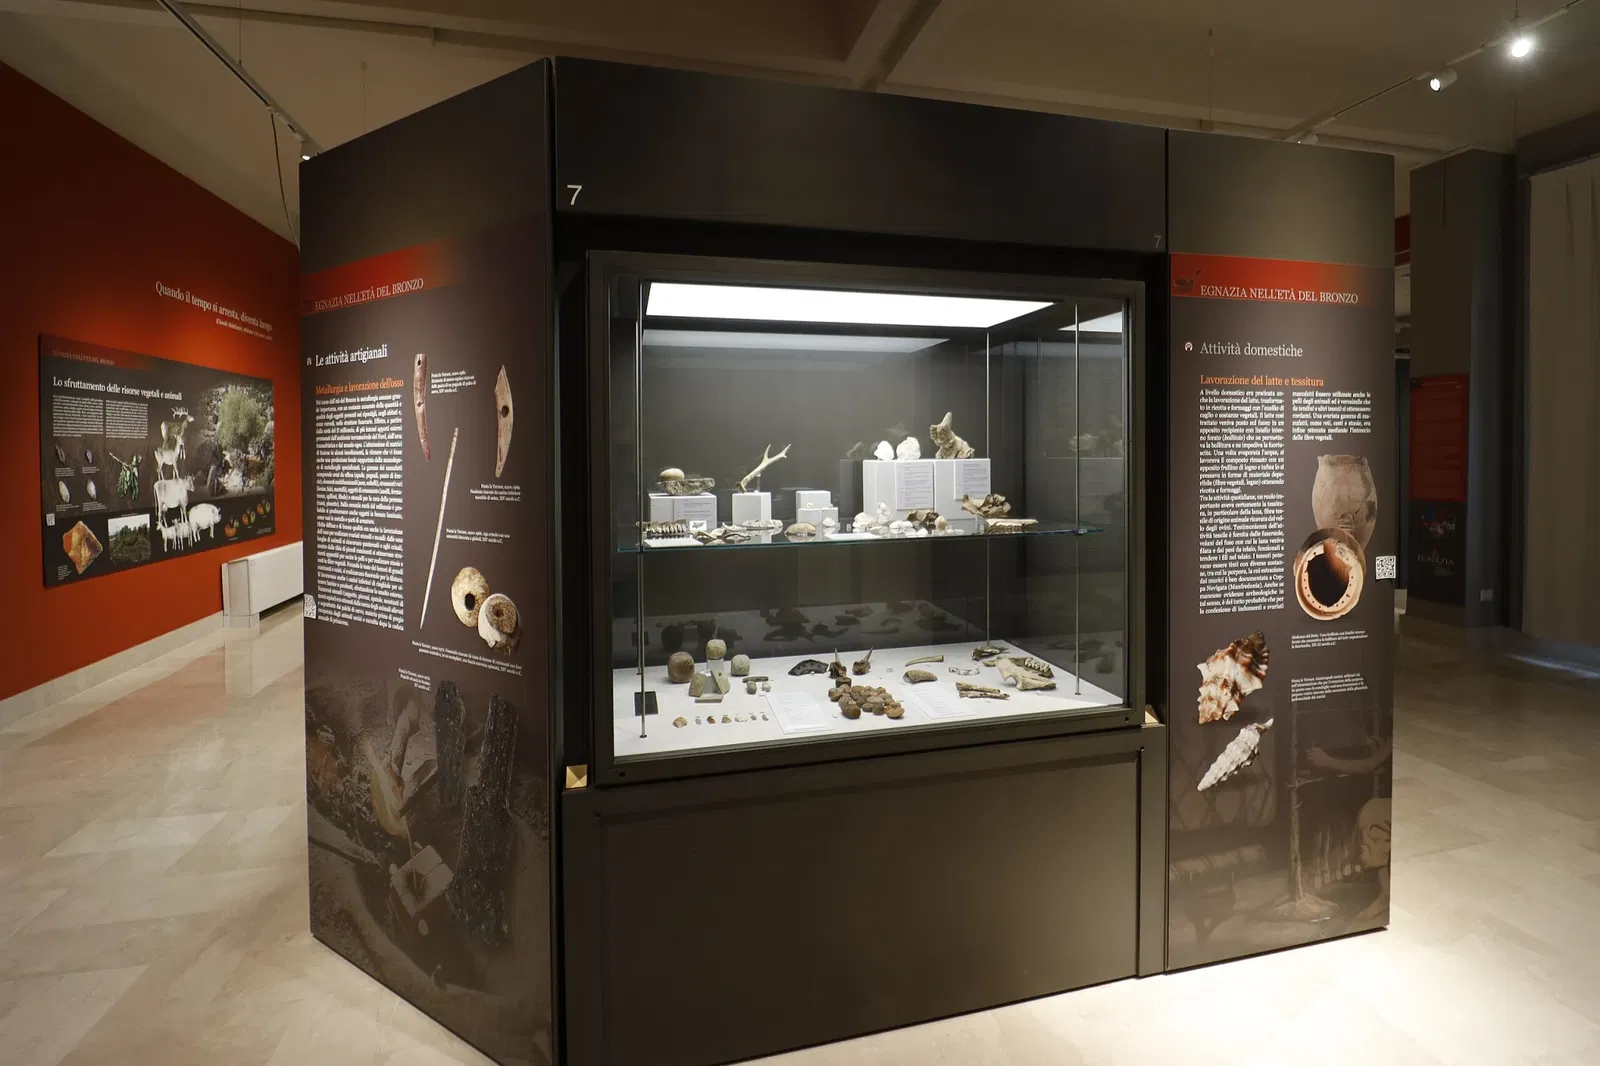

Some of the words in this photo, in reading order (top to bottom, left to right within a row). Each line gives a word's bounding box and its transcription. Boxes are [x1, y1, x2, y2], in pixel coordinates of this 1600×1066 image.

[566, 184, 582, 205] 7
[1153, 234, 1162, 248] 7
[314, 296, 343, 311] EGNAZIA
[376, 285, 390, 298] DEL
[392, 278, 424, 294] BRONZO
[1200, 285, 1246, 298] EGNAZIA
[1298, 290, 1317, 302] DEL
[1320, 292, 1358, 304] BRONZO
[156, 281, 184, 301] Quando
[185, 291, 190, 303] il
[192, 295, 211, 311] tempo
[212, 302, 218, 313] si
[219, 306, 240, 321] arresta,
[240, 312, 259, 327] diventa
[259, 318, 272, 332] luogo
[1200, 342, 1241, 355] Attività
[1244, 342, 1303, 357] domestiche
[315, 355, 324, 366] Le
[325, 350, 349, 365] attività
[350, 344, 388, 364] artigianali
[1200, 375, 1249, 385] Lavorazione
[1251, 375, 1263, 385] del
[1265, 375, 1282, 386] latte
[1291, 376, 1324, 386] tessitura
[53, 376, 63, 387] Lo
[64, 378, 106, 392] sfruttamento
[106, 383, 120, 394] delle
[122, 385, 140, 396] risorse
[141, 389, 159, 399] vegetali
[164, 392, 182, 401] animali
[316, 383, 344, 396] Metallurgia
[348, 381, 378, 392] lavorazione
[380, 378, 404, 389] dell'osso
[1236, 419, 1248, 427] posto
[1200, 426, 1220, 434] apposito
[1221, 426, 1244, 434] recipiente
[1226, 456, 1248, 464] composto
[1200, 501, 1220, 509] portante
[1213, 509, 1238, 517] particolare
[1206, 524, 1217, 532] degli
[1233, 530, 1248, 538] fornita
[1250, 559, 1266, 567] diverse
[1246, 588, 1277, 598] archeologiche
[1205, 606, 1231, 614] confezione
